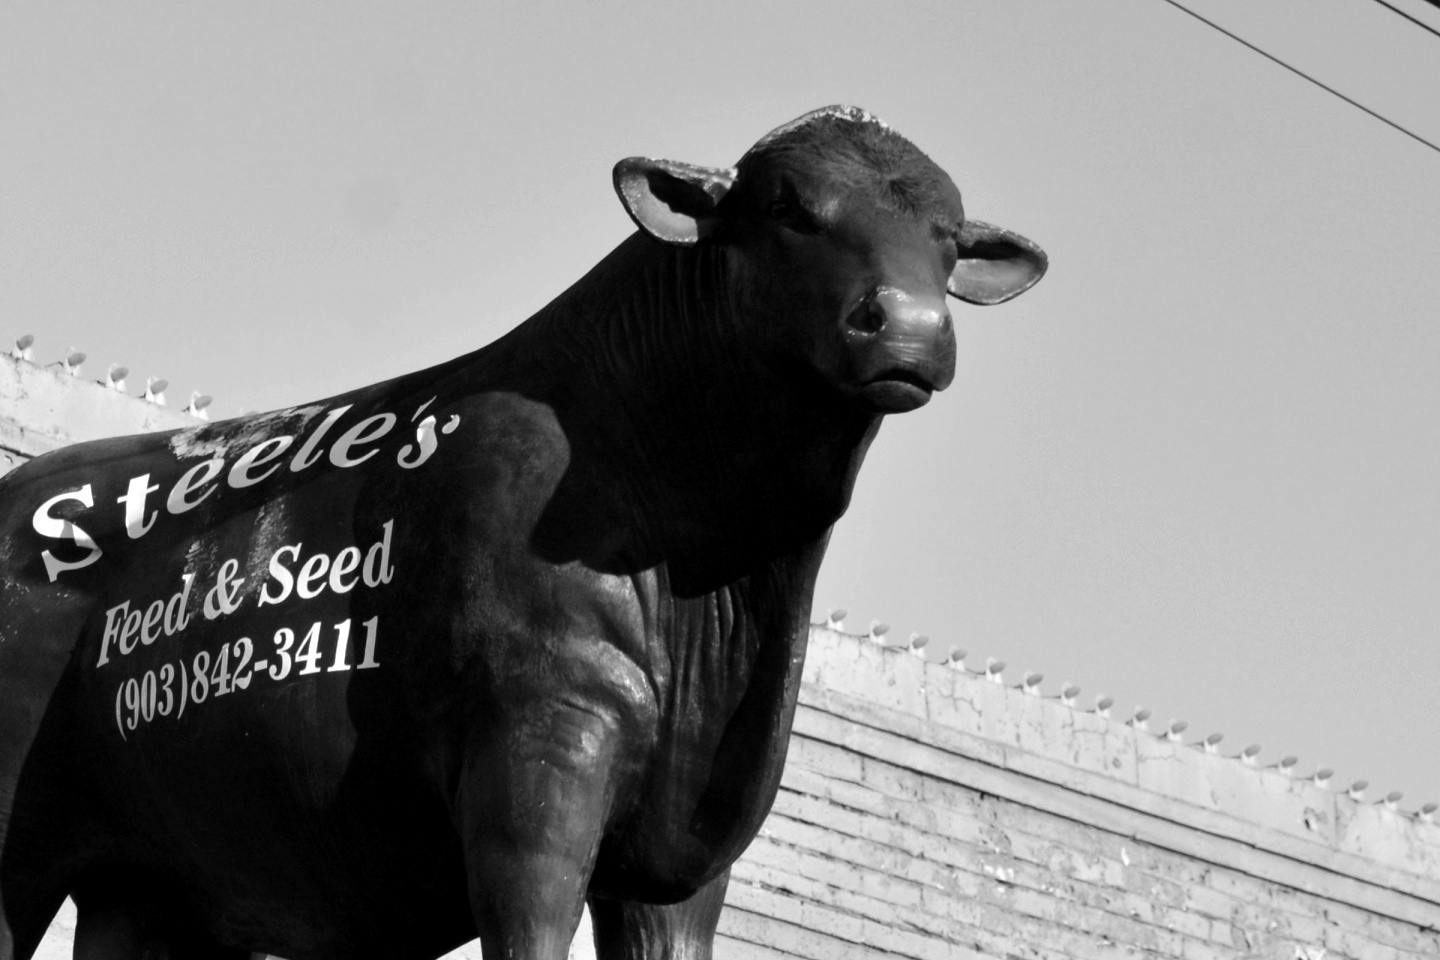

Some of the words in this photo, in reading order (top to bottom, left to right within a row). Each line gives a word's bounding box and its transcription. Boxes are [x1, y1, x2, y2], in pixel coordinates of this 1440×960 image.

[96, 574, 194, 669] Feed
[203, 558, 246, 620] &
[258, 518, 395, 608] Seed
[115, 615, 381, 741] (903)842-3411
